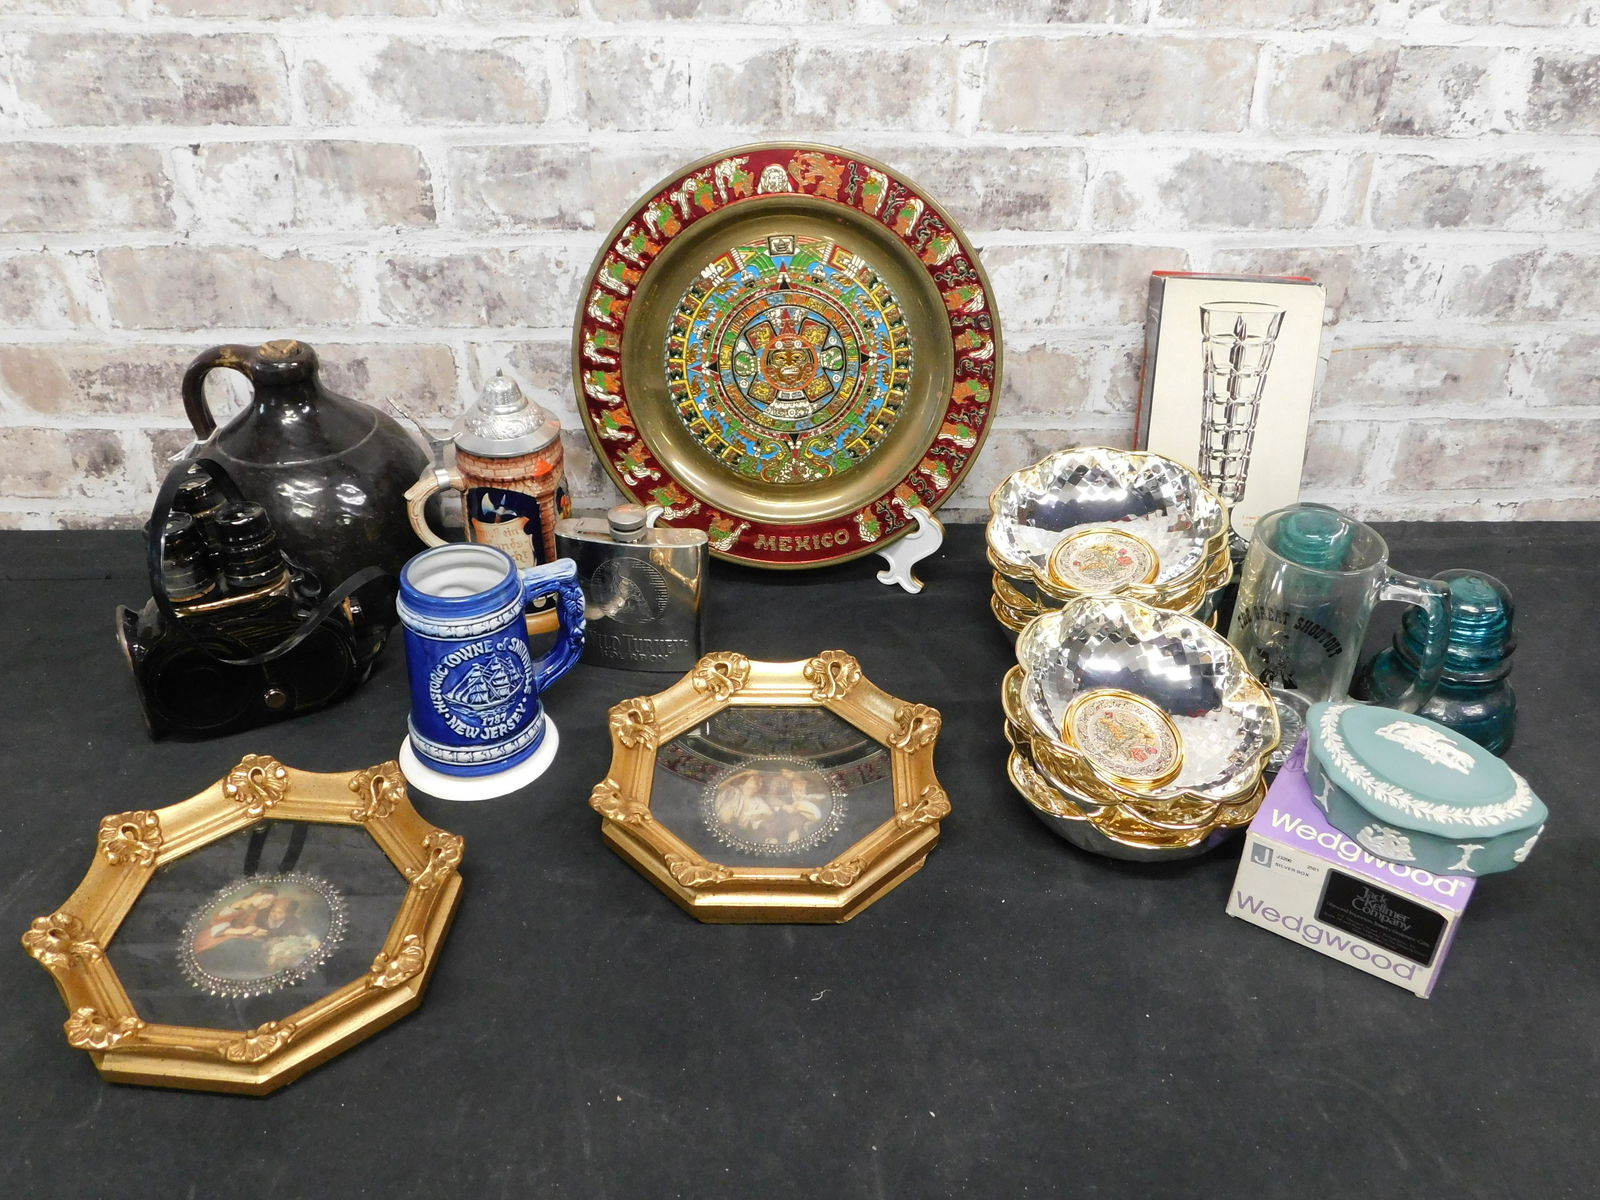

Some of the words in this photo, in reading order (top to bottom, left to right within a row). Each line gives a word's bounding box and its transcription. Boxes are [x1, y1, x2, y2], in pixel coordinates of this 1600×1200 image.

[753, 528, 850, 552] MEXICO
[1254, 605, 1291, 626] GREAT
[1293, 616, 1343, 659] SHOOTOUT
[429, 664, 449, 715] HISTORIC
[444, 639, 494, 669] TOWNE
[446, 714, 481, 740] NEW
[479, 703, 527, 740] JERSEY
[481, 713, 508, 727] 1787
[1254, 848, 1270, 865] J
[1357, 885, 1389, 903] Jack
[1351, 896, 1412, 931] Company
[1364, 899, 1411, 923] Kellmer
[1236, 890, 1417, 982] Wedgwood
